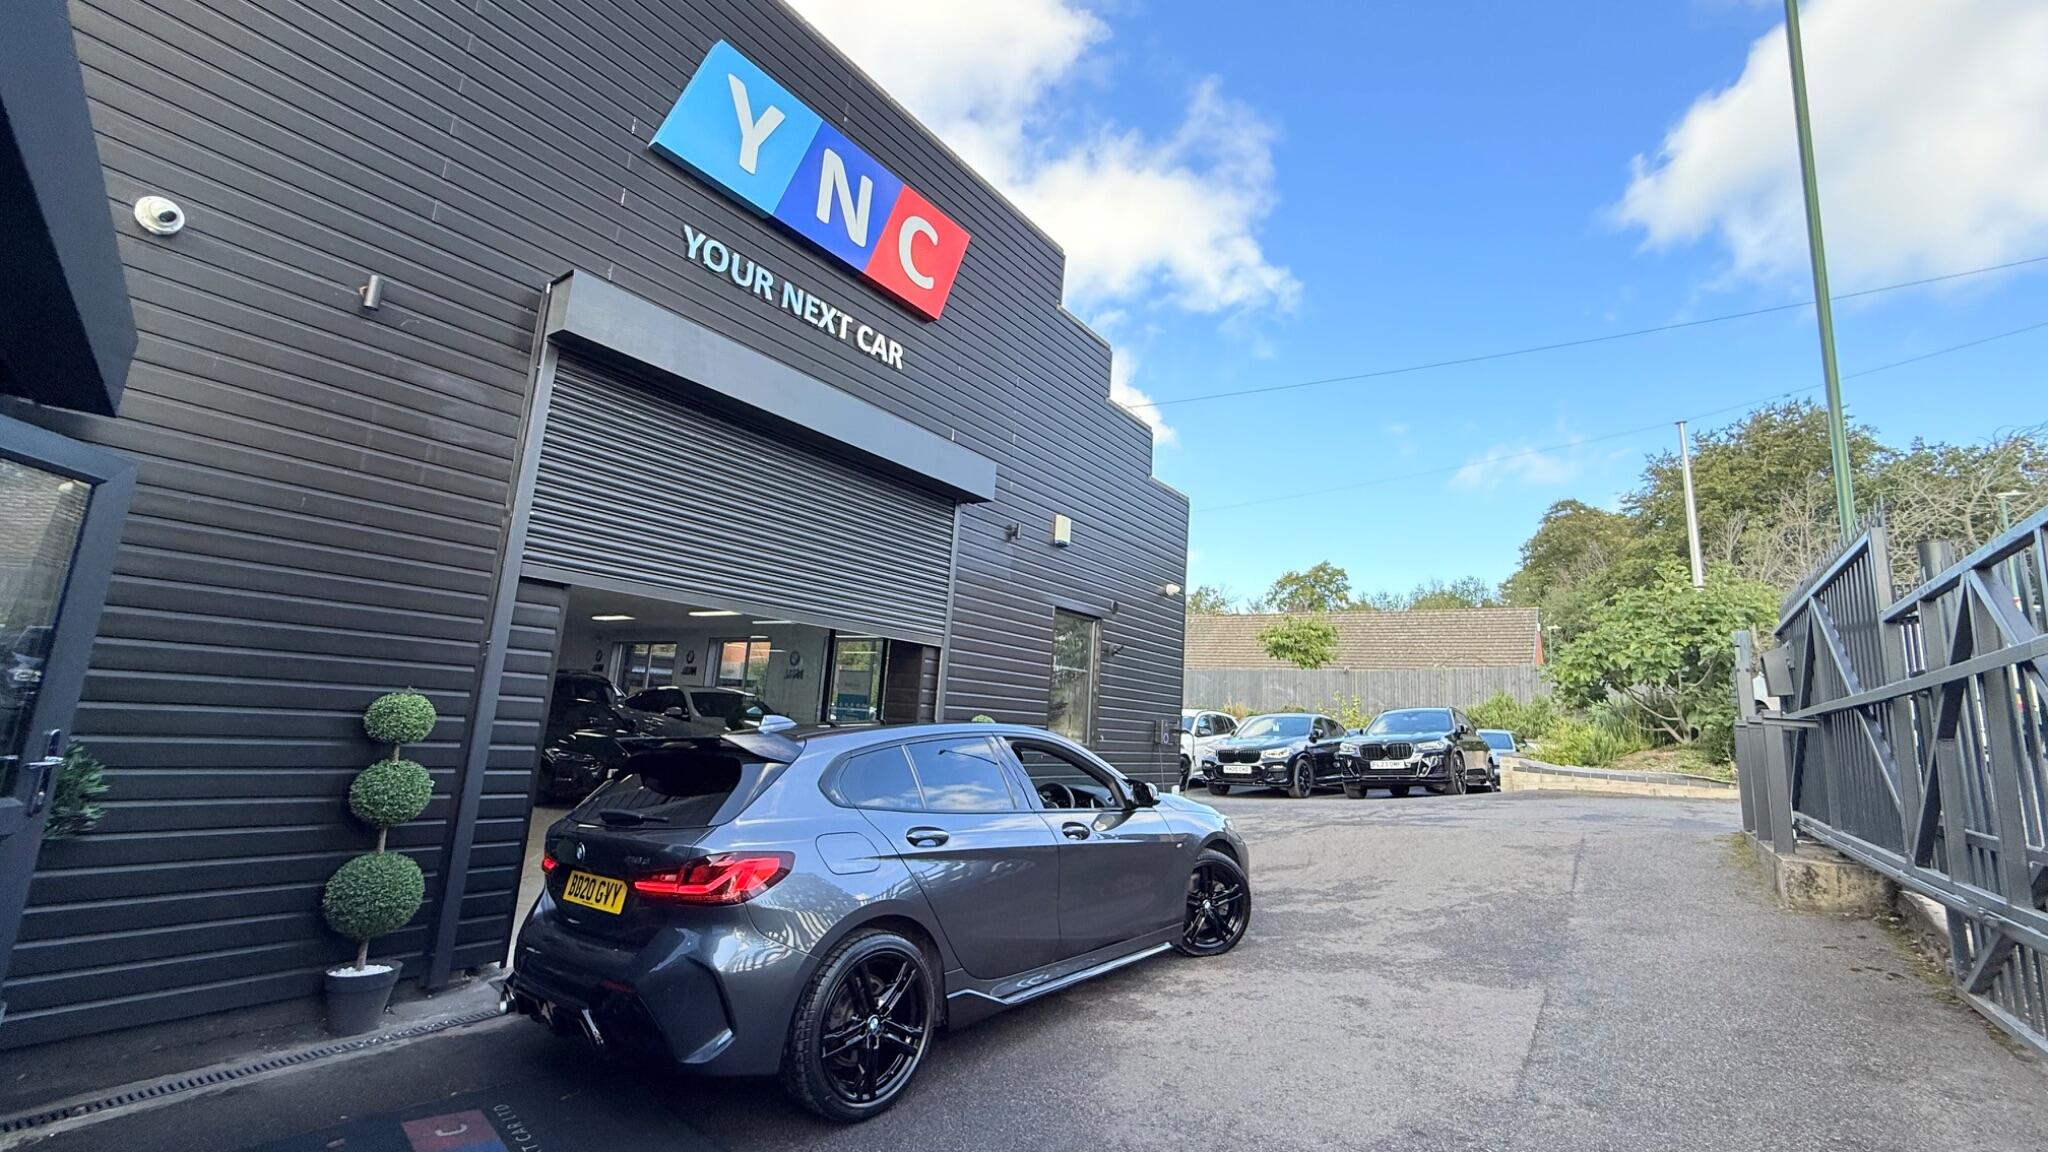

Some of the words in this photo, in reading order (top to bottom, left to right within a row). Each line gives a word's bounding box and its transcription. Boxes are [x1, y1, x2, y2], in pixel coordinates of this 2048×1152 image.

[727, 73, 939, 290] YNC
[684, 224, 774, 302] YOUR
[782, 280, 853, 342] NEXT
[857, 324, 904, 370] CAR
[594, 880, 623, 908] GVY
[493, 1103, 517, 1122] LTD
[506, 1120, 532, 1142] CAR
